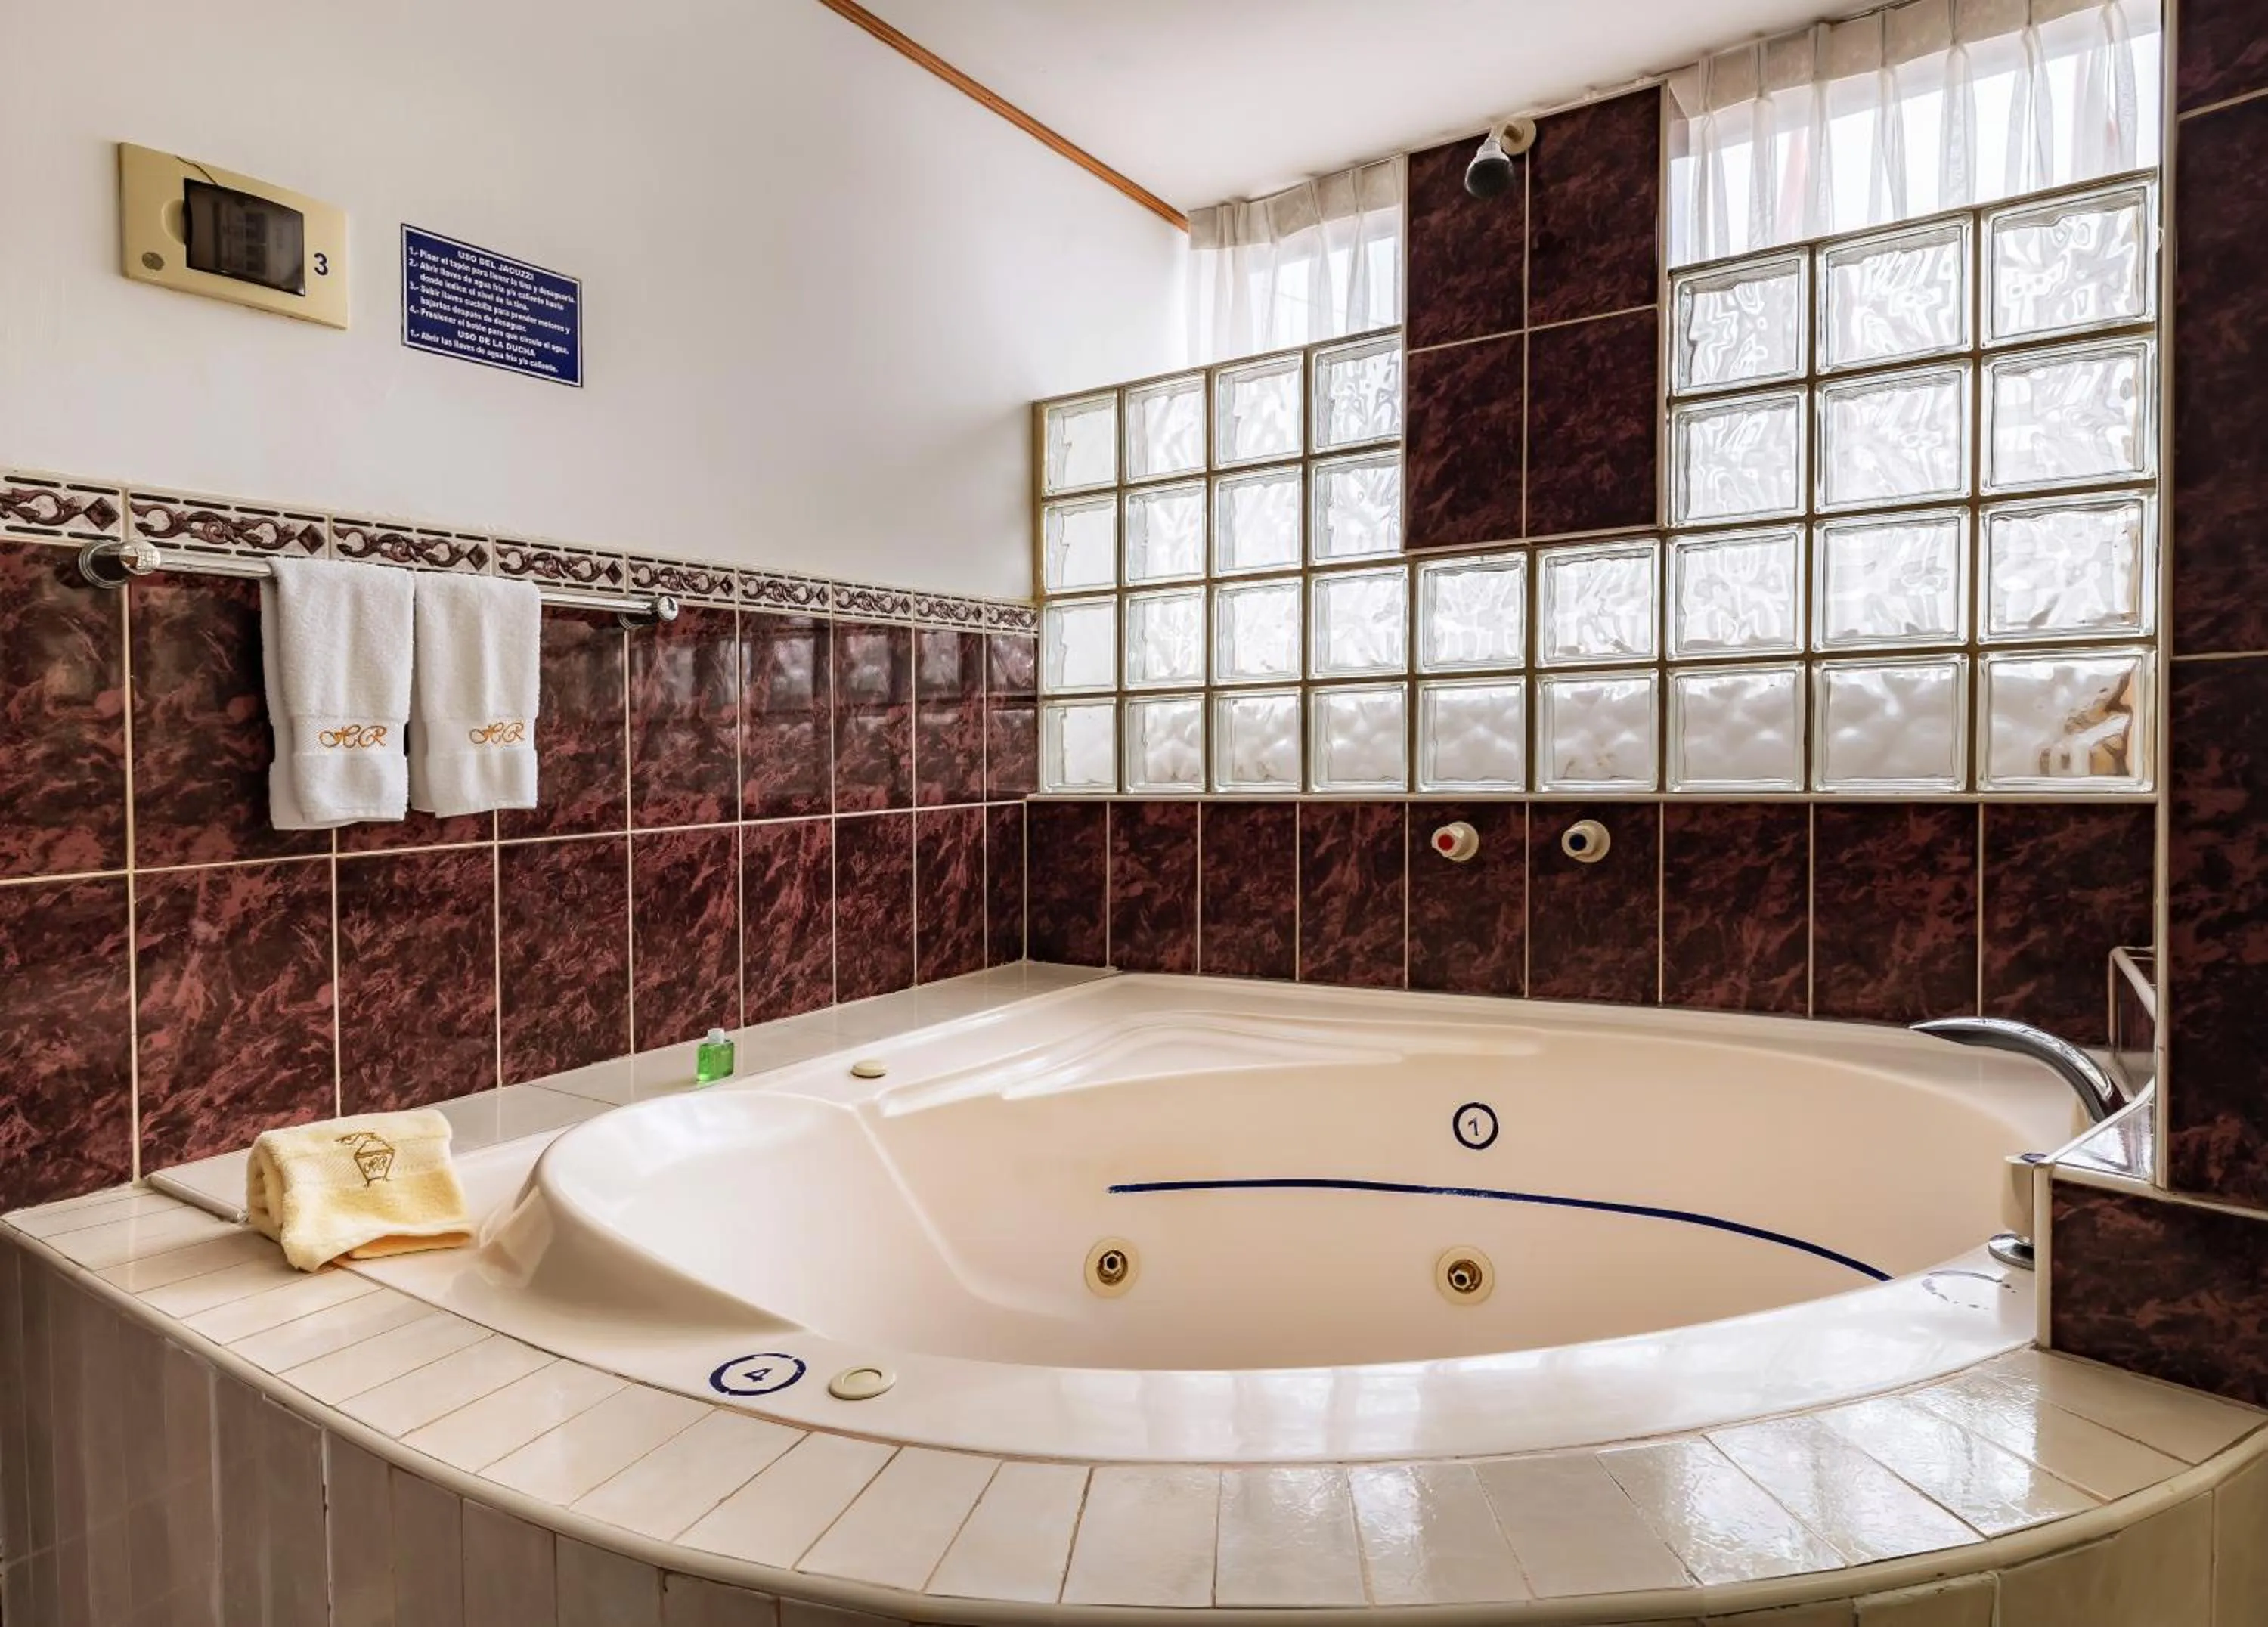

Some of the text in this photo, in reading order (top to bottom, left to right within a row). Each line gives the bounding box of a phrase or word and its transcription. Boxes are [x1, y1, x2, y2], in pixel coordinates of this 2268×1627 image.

[314, 252, 329, 276] 3
[457, 250, 534, 280] USO DEL JACUZZI
[471, 267, 488, 277] para
[463, 274, 472, 284] de
[474, 279, 491, 290] agua
[483, 315, 492, 323] de
[494, 307, 510, 317] para
[488, 327, 504, 337] para
[505, 332, 518, 341] que
[457, 330, 535, 356] USO DE LA DUCHA
[476, 346, 485, 355] de
[487, 350, 504, 359] agua
[1467, 1117, 1479, 1136] 1
[742, 1367, 773, 1382] 4
